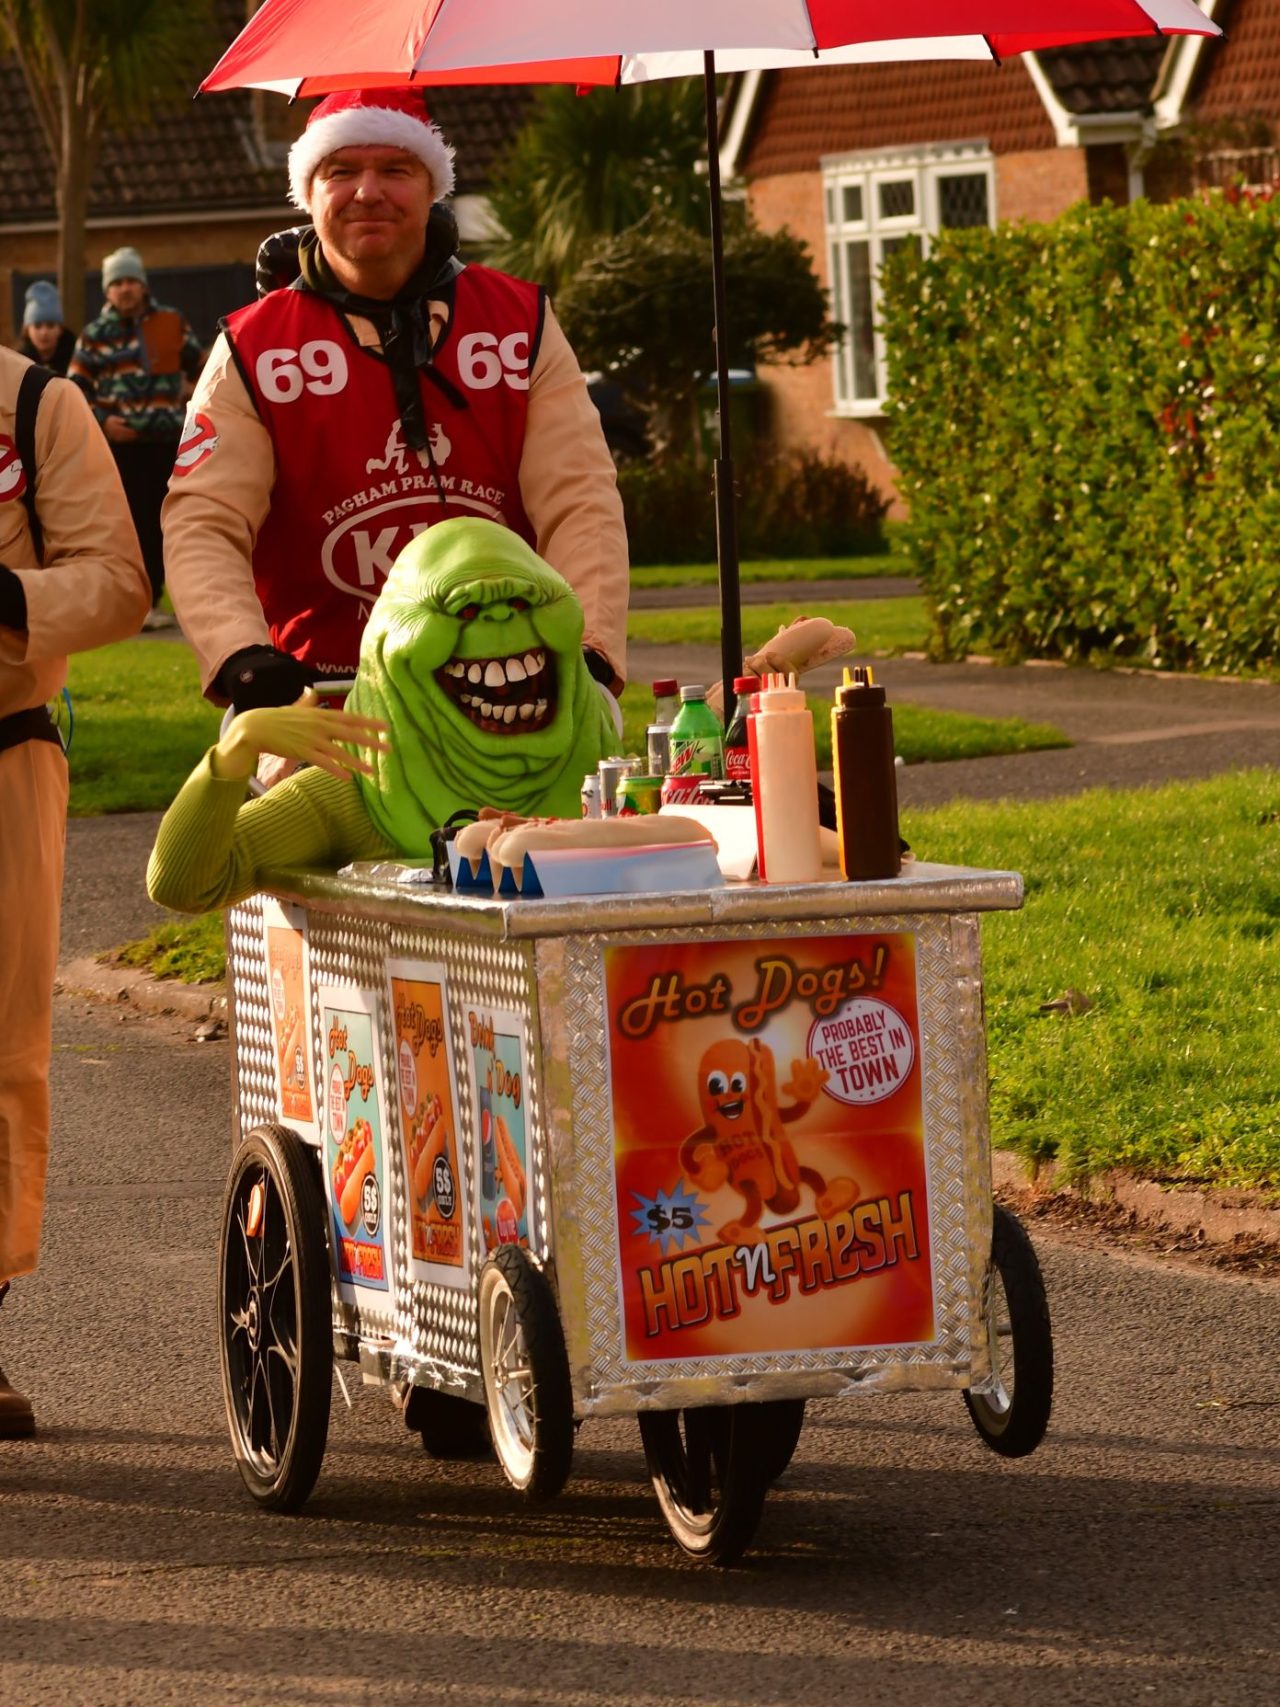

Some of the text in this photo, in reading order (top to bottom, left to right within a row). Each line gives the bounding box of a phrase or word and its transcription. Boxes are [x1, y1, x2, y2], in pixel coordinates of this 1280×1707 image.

[255, 339, 349, 404] 69
[456, 331, 530, 391] 69
[321, 475, 505, 526] PAGHAM PRAM RACE
[621, 946, 885, 1036] Hot Dogs!
[815, 1027, 906, 1070] THE BEST IN
[821, 1009, 886, 1045] PROBABLY
[343, 1050, 375, 1103] Dogs
[836, 1054, 900, 1094] TOWN
[363, 1185, 378, 1213] 5$
[646, 1204, 695, 1235] $5
[639, 1246, 740, 1336] HOT
